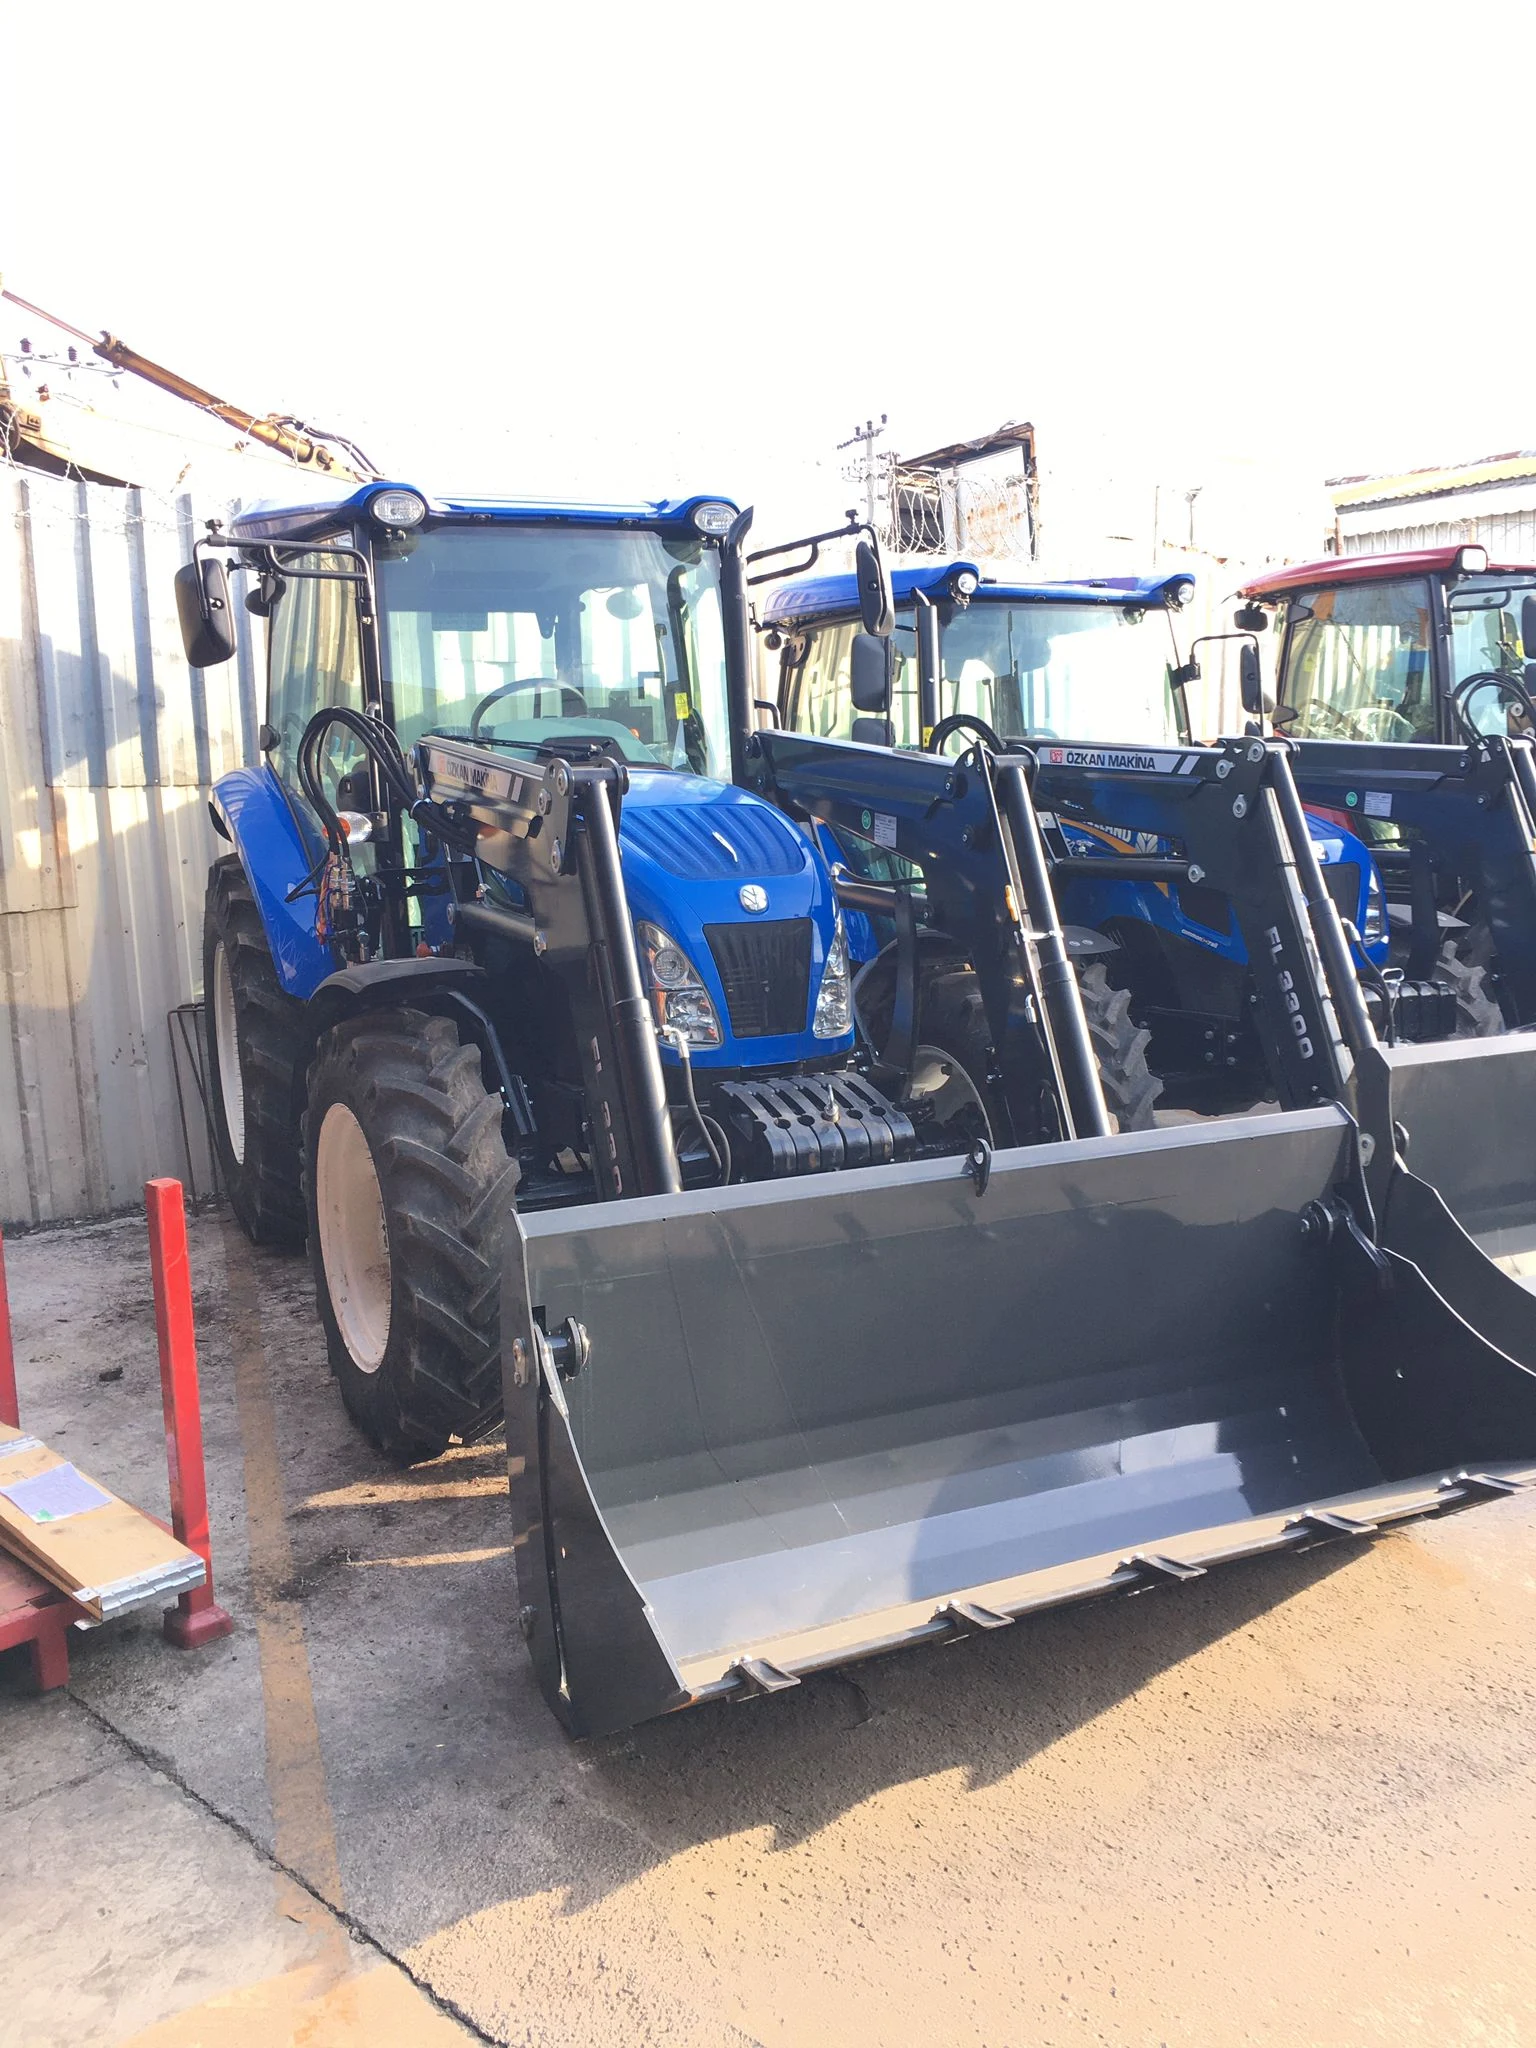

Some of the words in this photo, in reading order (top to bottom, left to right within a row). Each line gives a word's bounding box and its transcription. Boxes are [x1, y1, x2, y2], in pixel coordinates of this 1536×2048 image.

[1066, 750, 1105, 767] ÖZKAN
[1107, 753, 1156, 770] MAKİNA
[1264, 926, 1283, 965] FL
[1279, 970, 1313, 1059] 3300
